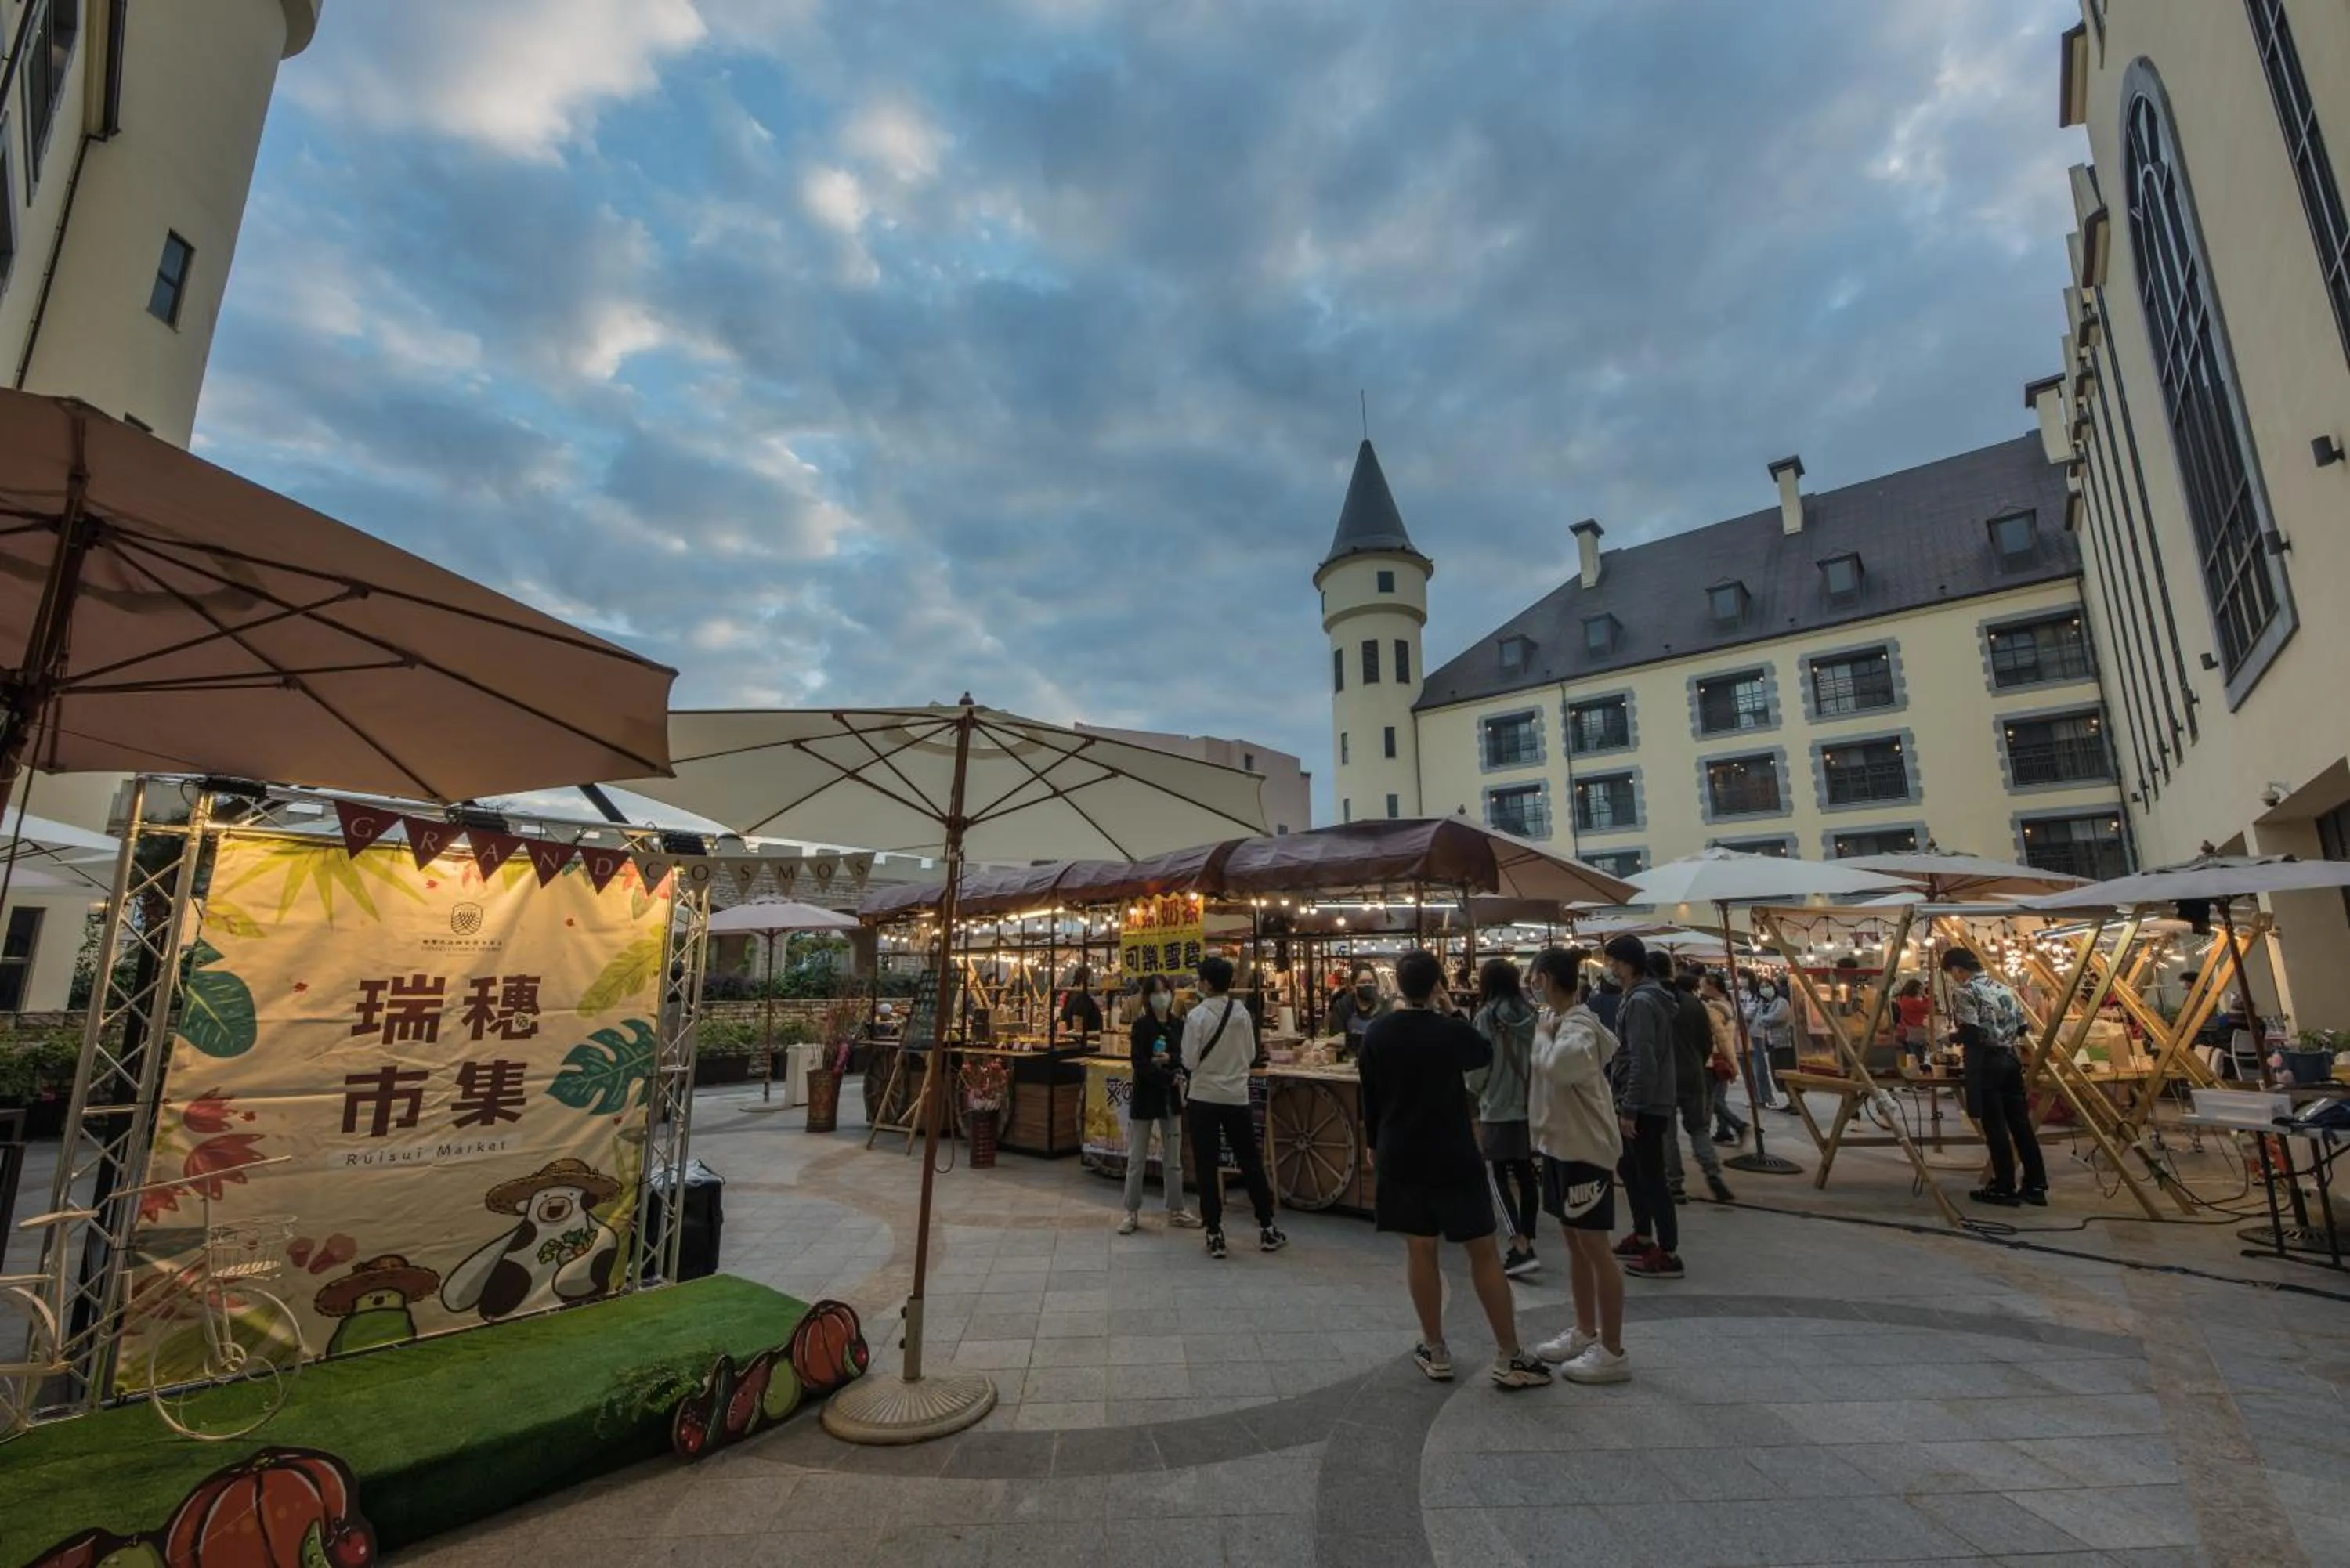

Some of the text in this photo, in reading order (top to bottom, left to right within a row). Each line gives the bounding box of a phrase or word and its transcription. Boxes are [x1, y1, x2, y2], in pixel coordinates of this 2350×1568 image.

[350, 817, 866, 882] GRAND COSMOS
[351, 974, 541, 1045] 瑞穗
[341, 1060, 528, 1137] 市集
[345, 1140, 507, 1165] Ruisui Market
[1568, 1180, 1602, 1205] NIKE
